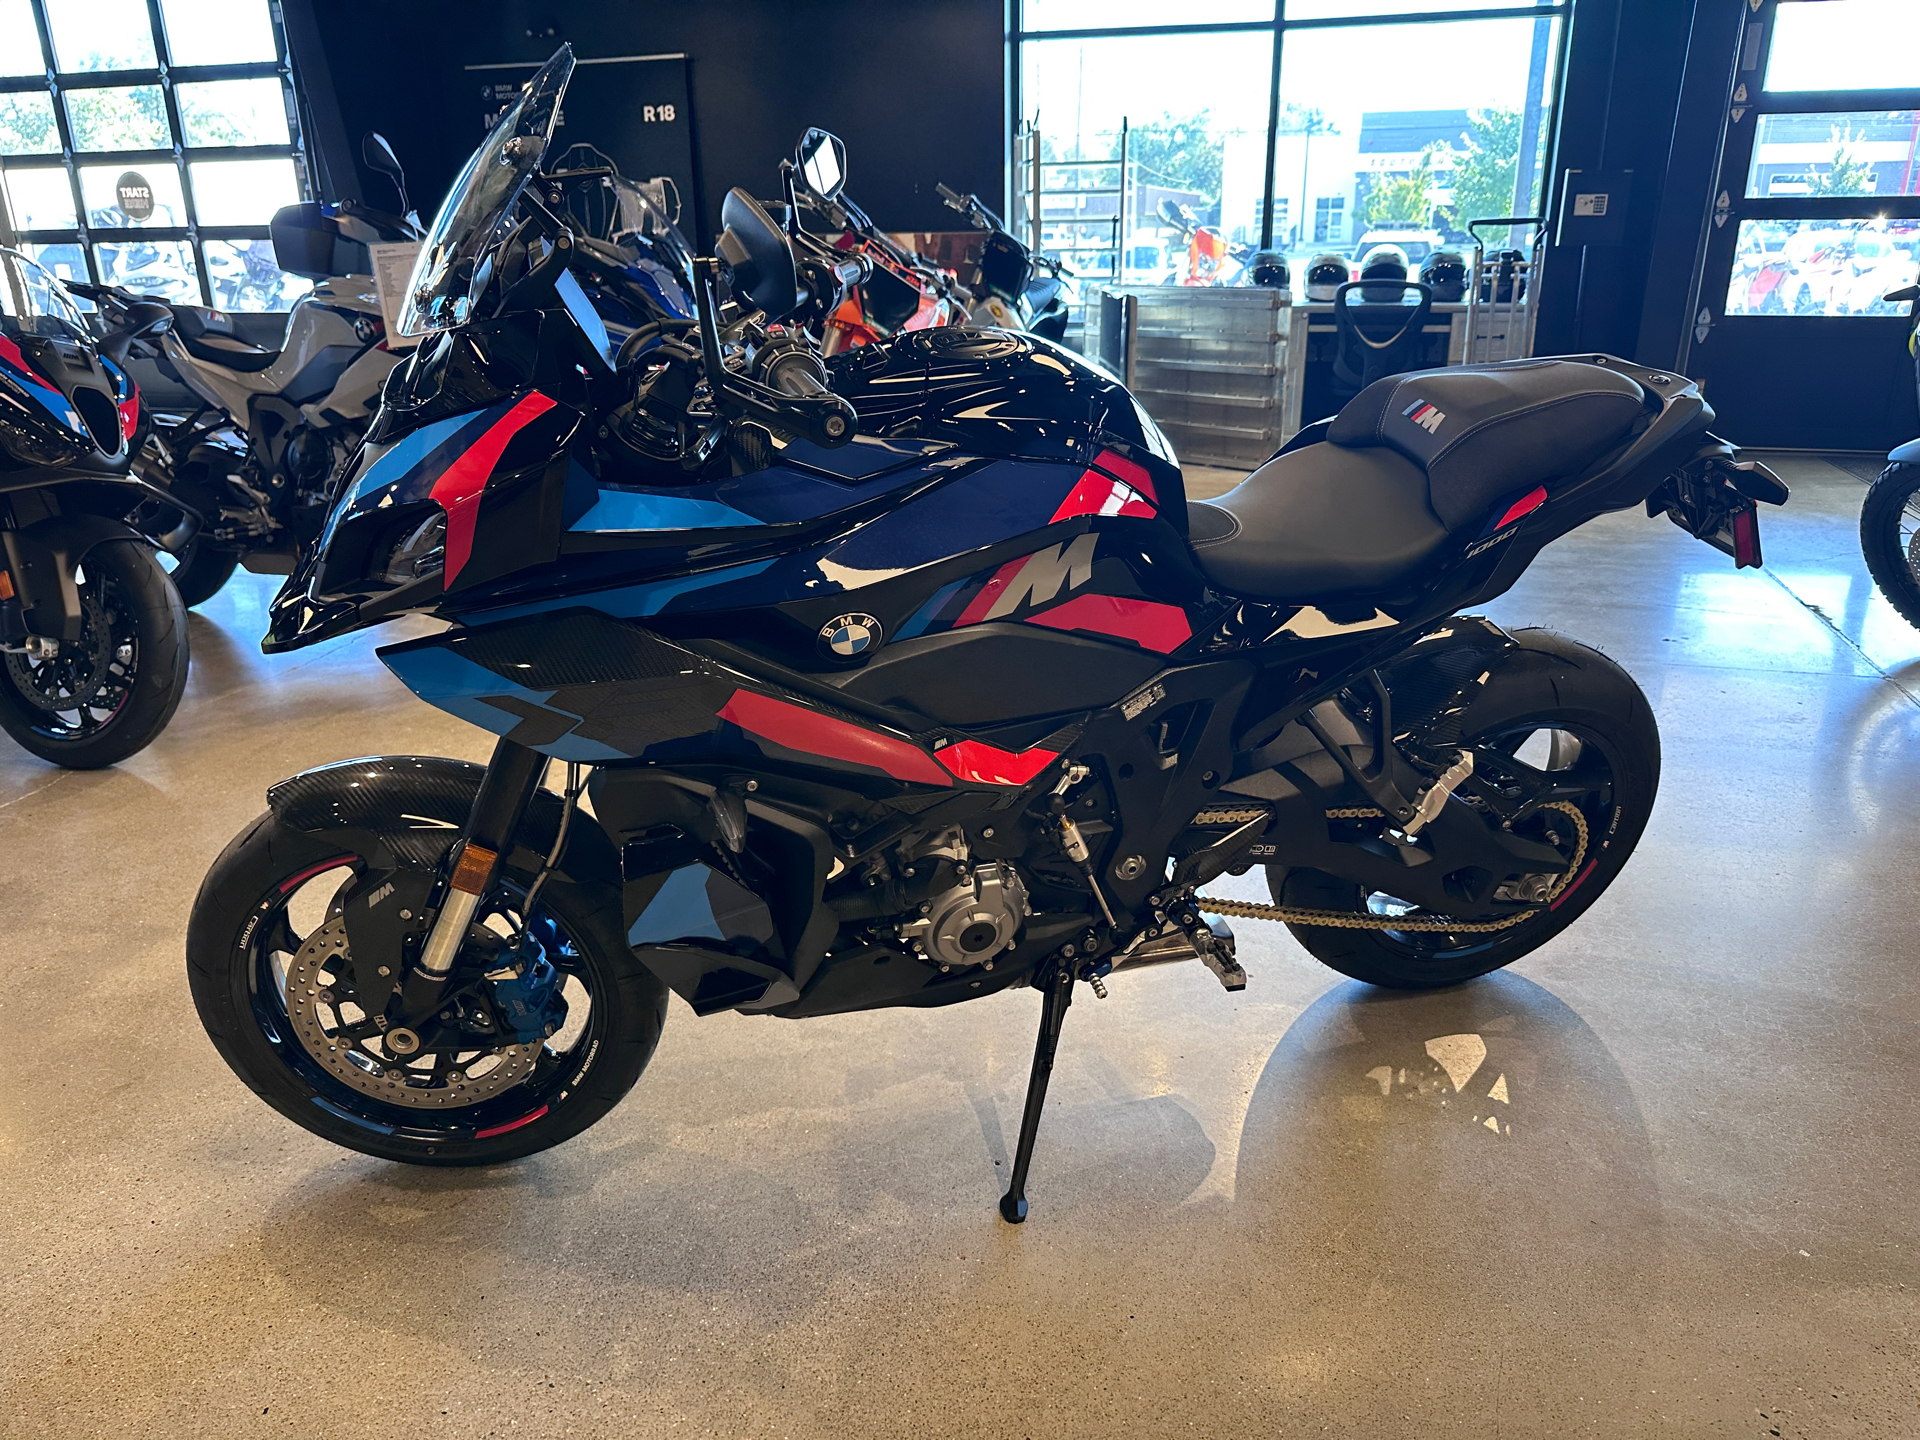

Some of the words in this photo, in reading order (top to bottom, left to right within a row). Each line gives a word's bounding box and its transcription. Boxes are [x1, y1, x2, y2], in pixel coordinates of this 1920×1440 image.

[494, 83, 513, 92] BMW
[1414, 406, 1446, 435] M
[1466, 526, 1518, 560] 1000
[982, 532, 1100, 622] M
[821, 615, 875, 639] BMW
[238, 915, 259, 951] Carbon
[571, 1070, 585, 1087] BMW
[582, 1039, 600, 1073] MOTORRAD
